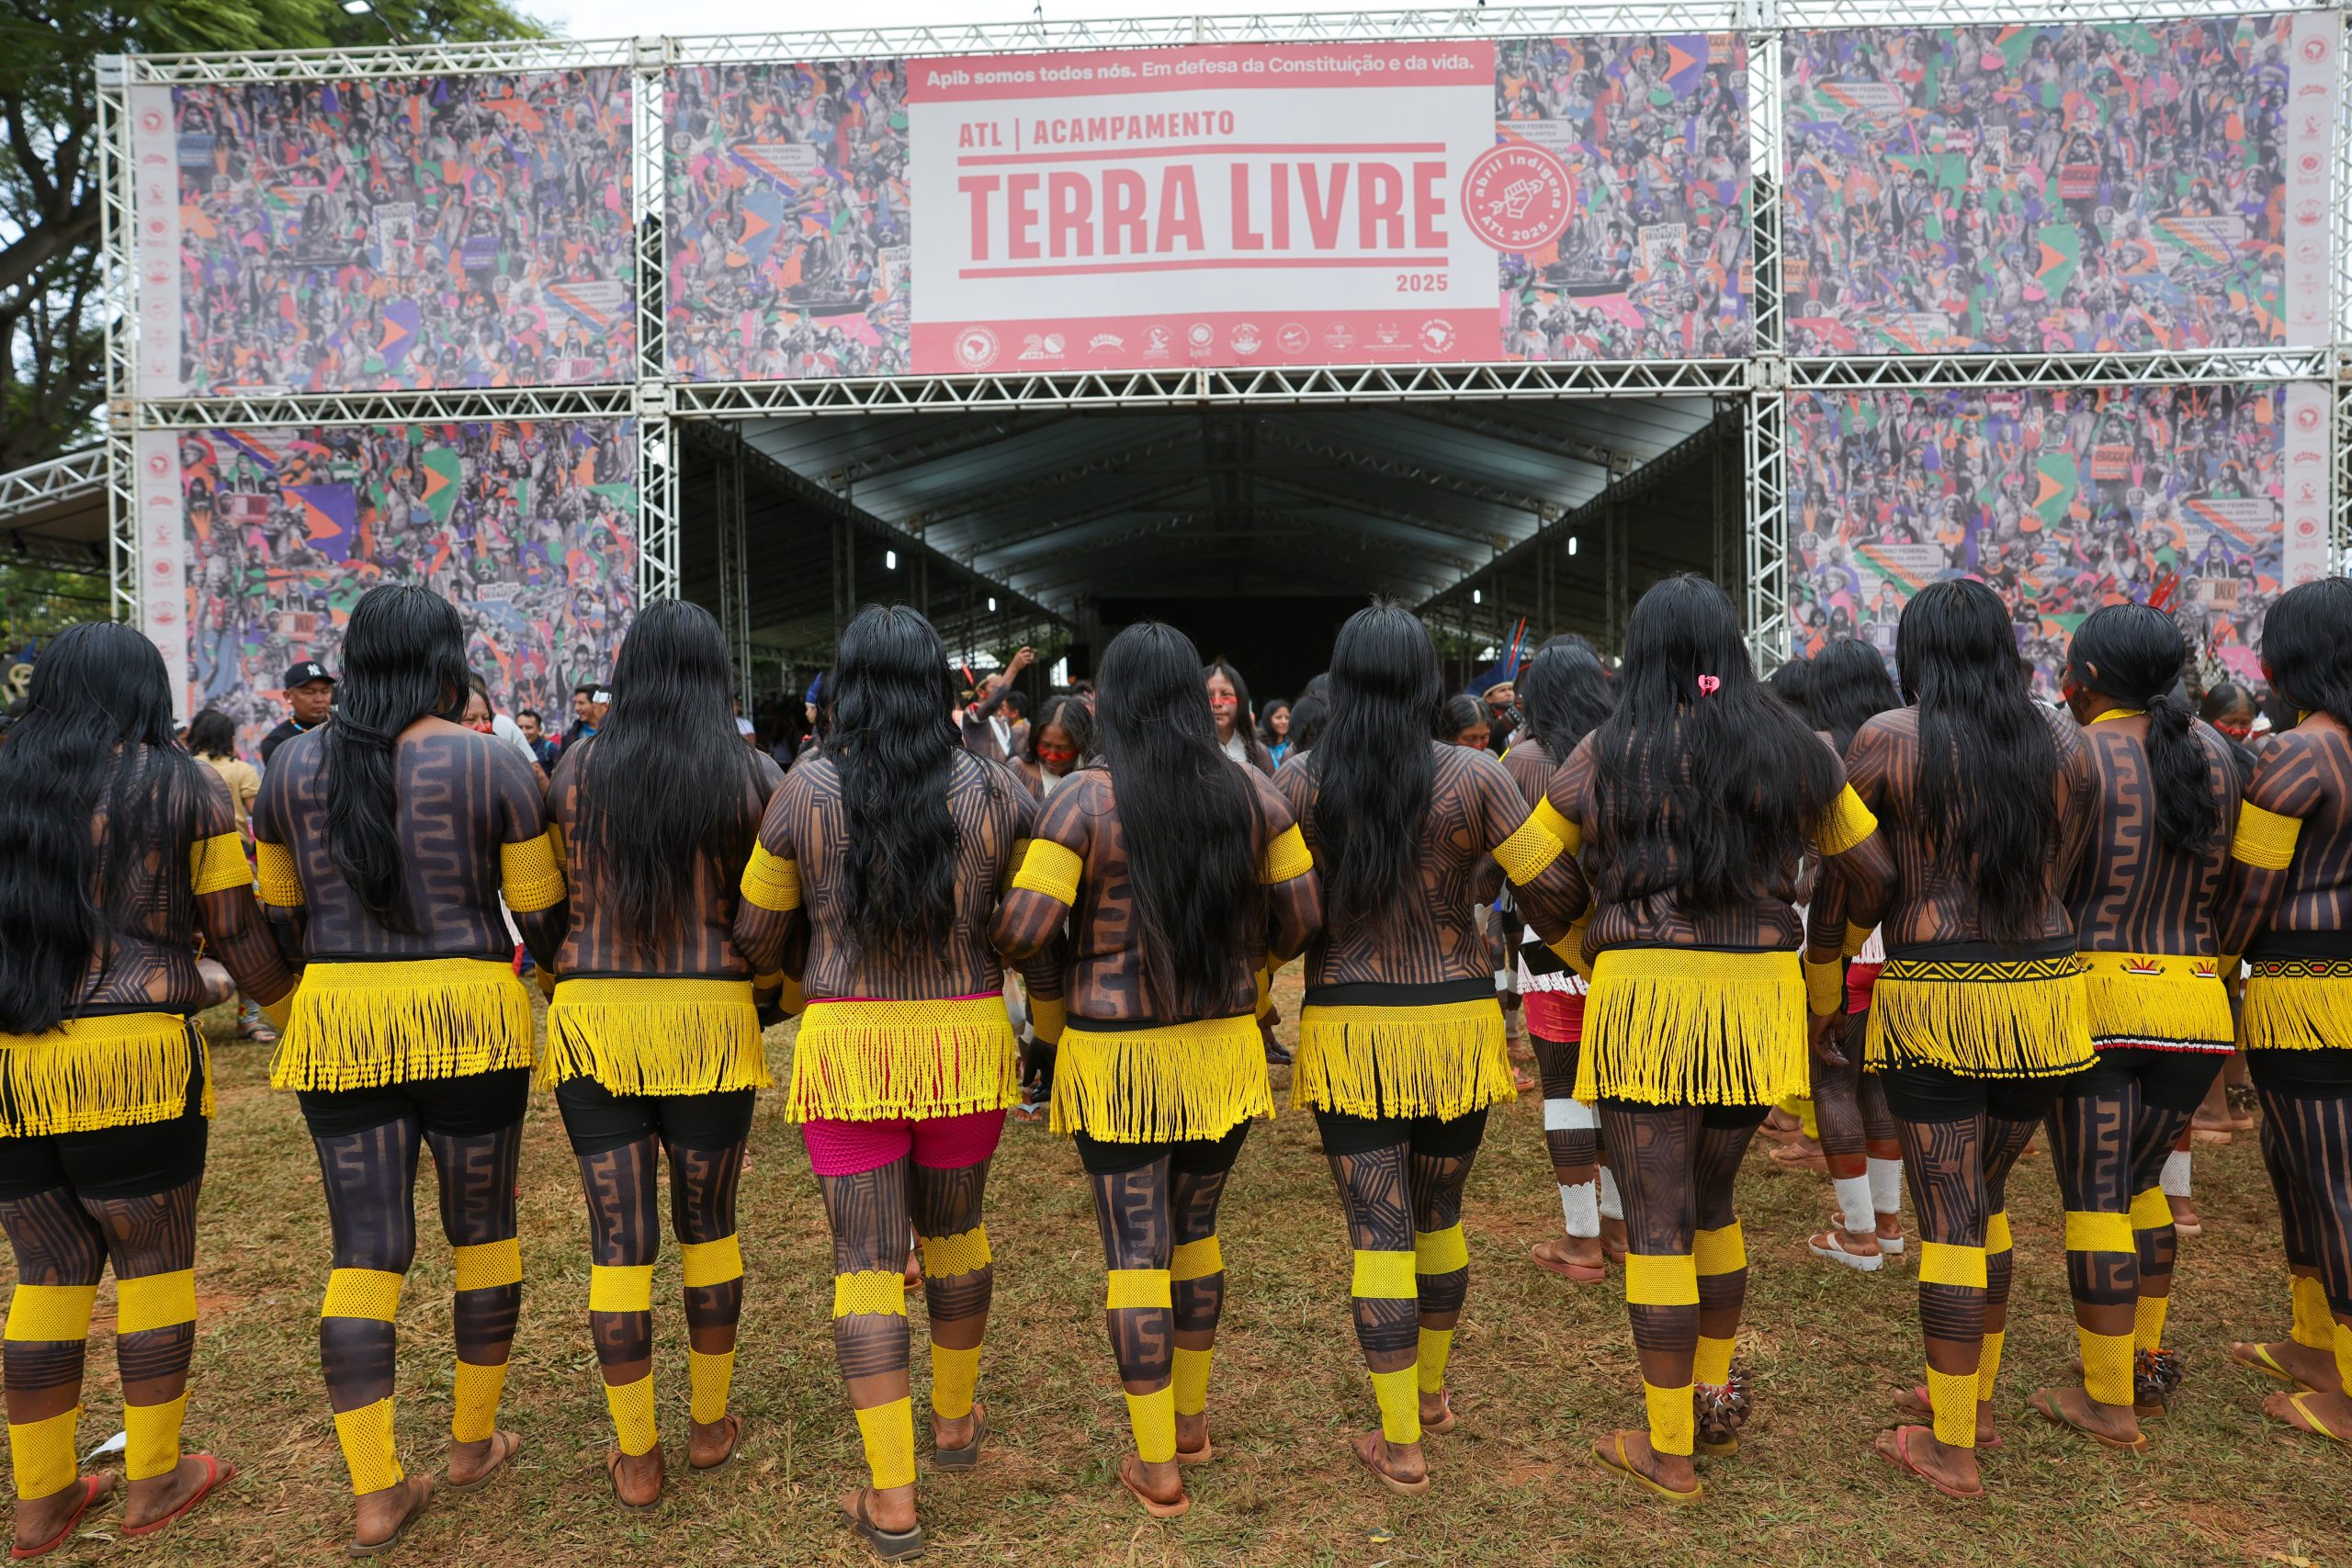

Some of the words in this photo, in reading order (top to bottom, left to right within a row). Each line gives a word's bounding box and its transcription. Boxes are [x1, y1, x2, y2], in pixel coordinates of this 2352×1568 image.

[926, 70, 970, 89] Apib
[973, 69, 1036, 85] somos
[1039, 65, 1093, 82] todos
[1096, 62, 1137, 79] nós.
[1141, 61, 1172, 77] Em
[1175, 58, 1238, 75] defesa
[1241, 58, 1265, 73] da
[1268, 54, 1385, 76] Constituição
[1388, 58, 1401, 72] e
[1402, 55, 1429, 72] da
[1430, 53, 1475, 71] vida.
[959, 122, 1001, 148] ATL
[1034, 109, 1235, 144] ACAMPAMENTO
[1475, 159, 1504, 197] abril
[1510, 153, 1562, 209] indígena
[957, 164, 1205, 261] TERRA
[1229, 161, 1449, 251] LIVRE
[1480, 215, 1506, 238] ATL
[1511, 220, 1548, 242] 2025
[1396, 274, 1448, 292] 2025
